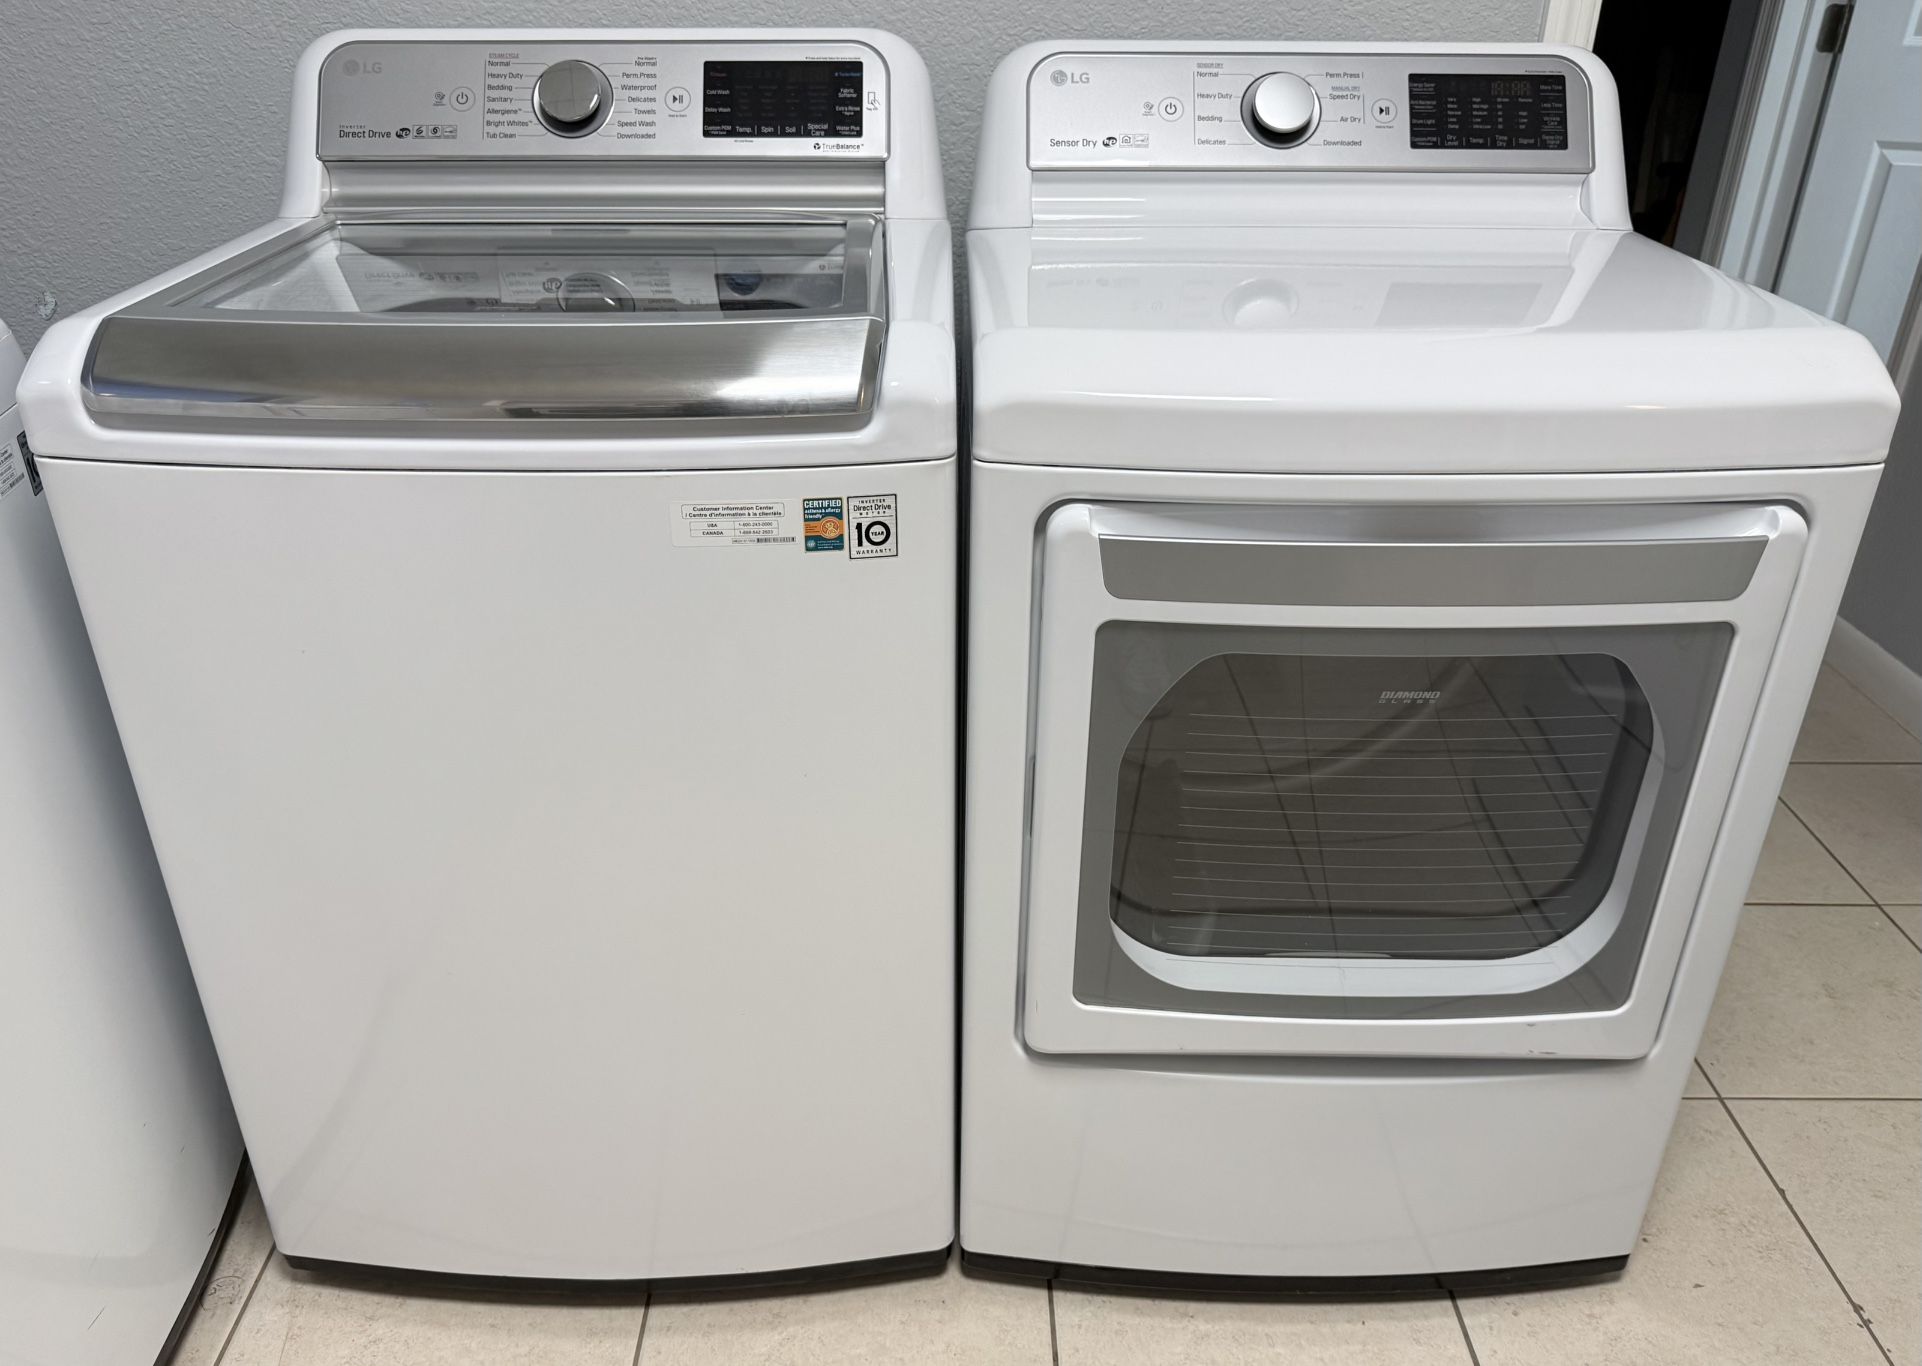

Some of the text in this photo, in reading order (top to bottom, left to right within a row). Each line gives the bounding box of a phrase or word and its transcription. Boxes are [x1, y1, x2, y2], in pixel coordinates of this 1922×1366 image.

[363, 61, 382, 74] LG
[488, 72, 523, 81] Heavy Duty
[1071, 72, 1090, 84] LG
[487, 96, 513, 104] Sanitary
[1197, 92, 1233, 101] Heavy Duty
[1349, 93, 1360, 101] Dry
[1197, 115, 1223, 123] Bedding
[1350, 116, 1361, 124] Dry
[486, 120, 505, 128] Bright
[617, 120, 637, 128] Speed
[761, 126, 774, 134] Spin
[339, 130, 392, 139] Direct Drive
[1050, 138, 1097, 149] Sensor Dry
[1197, 138, 1226, 146] Delicates
[804, 500, 841, 508] CERTIFIED
[874, 503, 891, 511] Drive
[855, 520, 891, 547] 10
[871, 529, 885, 537] YEAR
[1380, 691, 1441, 699] DIAMOND
